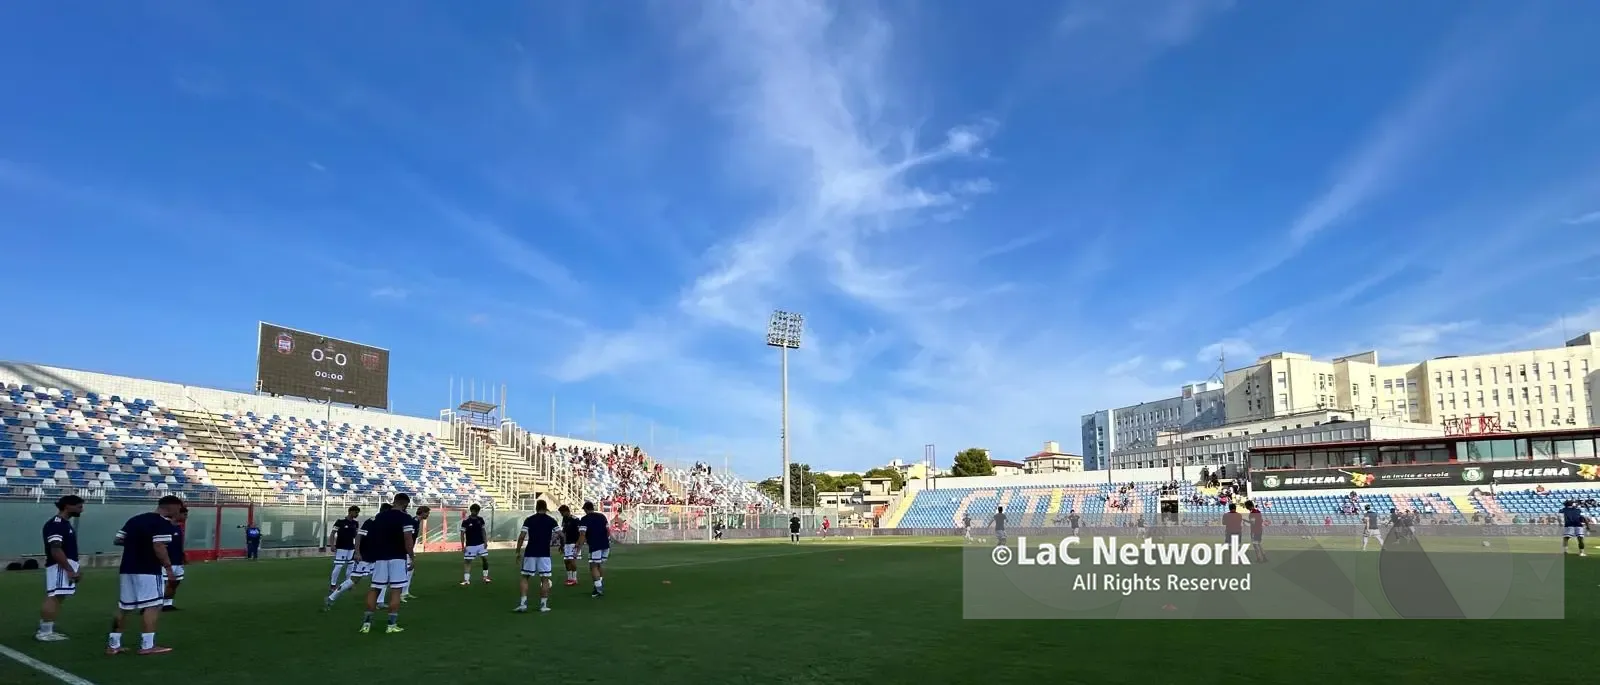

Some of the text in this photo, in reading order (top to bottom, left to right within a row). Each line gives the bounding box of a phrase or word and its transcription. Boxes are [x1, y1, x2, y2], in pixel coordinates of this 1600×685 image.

[315, 370, 343, 381] 00:00
[1492, 467, 1570, 478] BUSCEMA
[1284, 475, 1345, 485] BUSCEMA
